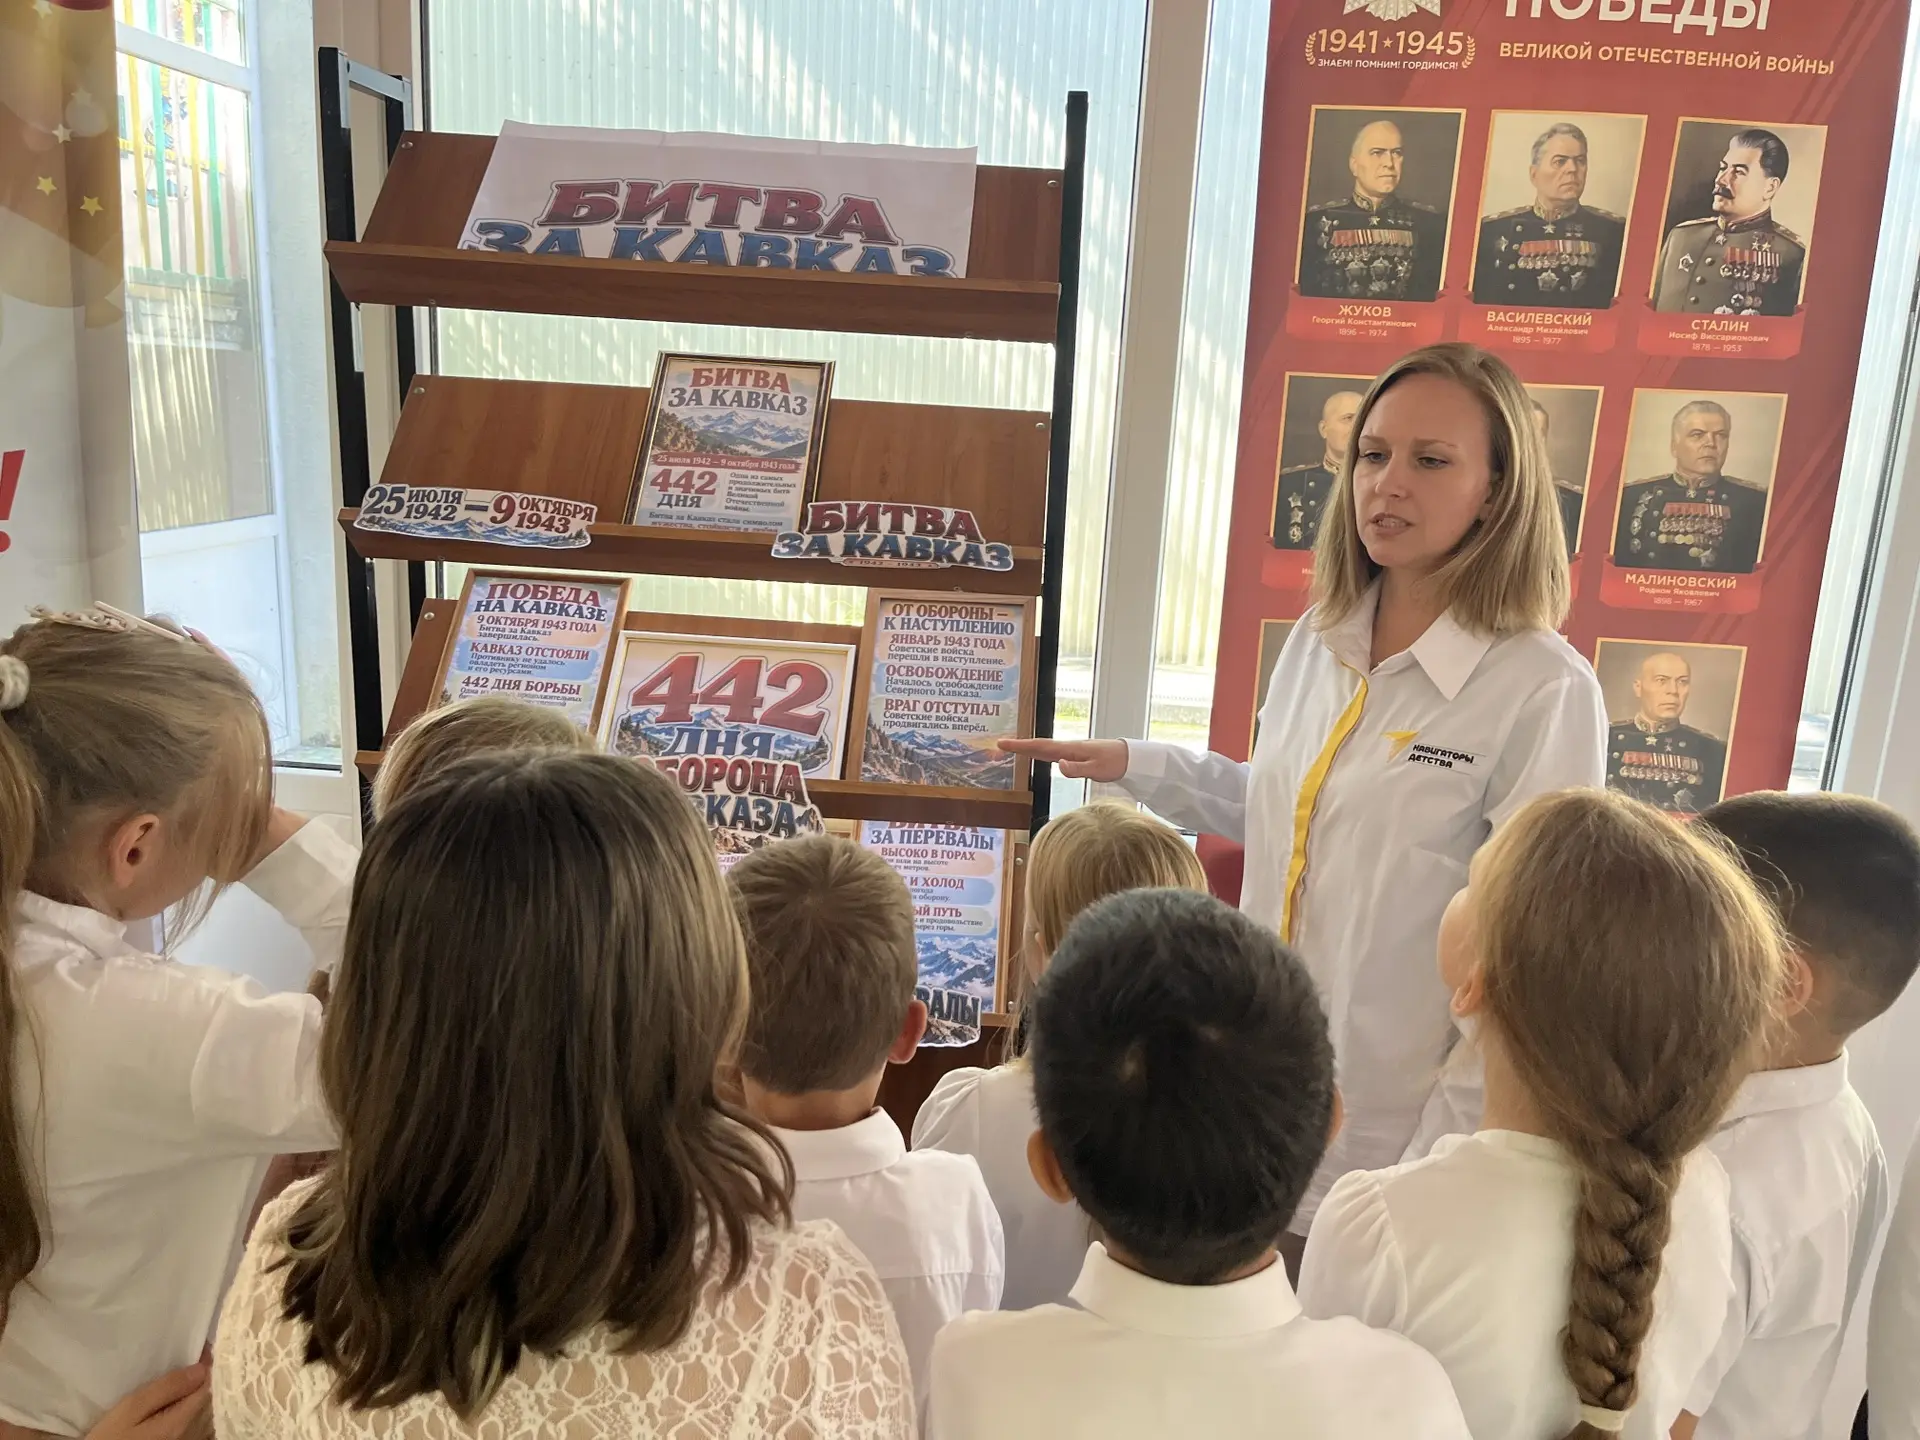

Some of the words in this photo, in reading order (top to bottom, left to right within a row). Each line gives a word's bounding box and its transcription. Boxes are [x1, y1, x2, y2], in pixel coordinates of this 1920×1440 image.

[1317, 29, 1379, 54] 1941
[1395, 30, 1464, 55] 1945
[1317, 58, 1353, 68] ЗНАЕМ!
[1355, 59, 1400, 69] ПОМНИМ!
[1402, 61, 1459, 71] ГОРДИМСЯ!
[1499, 41, 1593, 61] ВЕЛИКОЙ
[1598, 45, 1761, 71] ОТЕЧЕСТВЕННОЙ
[1765, 54, 1835, 75] ВОЙНЫ
[537, 180, 898, 245] БИТВА
[477, 221, 585, 257] ЗА
[609, 227, 957, 278] КАВКАЗ
[1338, 305, 1392, 317] ЖУКОВ
[1486, 311, 1593, 326] ВАСИЛЕВСКИЙ
[1312, 316, 1346, 325] Георгий
[1347, 317, 1417, 328] Константинович
[1487, 324, 1534, 333] Александр
[1536, 326, 1588, 335] Михайлович
[1691, 320, 1750, 332] СТАЛИН
[1368, 329, 1388, 337] 1974
[1668, 331, 1698, 341] Иосиф
[1700, 332, 1769, 342] Виссарионович
[690, 367, 791, 394] БИТВА
[668, 387, 703, 408] ЗА
[710, 389, 808, 415] КАВКАЗ
[657, 454, 667, 463] 25
[693, 456, 711, 465] 1942
[721, 459, 727, 467] 9
[727, 459, 759, 469] октября
[761, 460, 778, 469] 1943
[779, 463, 796, 471] года
[650, 469, 718, 496] 442
[363, 486, 407, 515] 25
[407, 489, 463, 504] ИЮЛЯ
[657, 494, 702, 509] ДНЯ
[403, 503, 457, 521] 1942
[489, 494, 517, 524] 9
[518, 496, 595, 523] ОКТЯБРЯ
[514, 512, 572, 534] 1943
[805, 502, 985, 544] БИТВА
[773, 532, 833, 558] ЗА
[842, 534, 1012, 570] КАВКАЗ
[1625, 573, 1737, 589] МАЛИНОВСКИЙ
[485, 583, 602, 607] ПОБЕДА
[1639, 586, 1671, 595] Родион
[474, 600, 505, 613] НА
[510, 600, 608, 622] КАВКАЗЕ
[892, 603, 914, 616] ОТ
[917, 604, 994, 621] ОБОРОНЫ
[477, 615, 484, 624] 9
[486, 616, 539, 628] ОКТЯБРЯ
[542, 619, 567, 631] 1943
[569, 621, 597, 632] ГОДА
[479, 624, 506, 632] Битва
[520, 627, 552, 636] Кавказ
[883, 617, 896, 631] К
[900, 618, 1015, 636] НАСТУПЛЕНИЮ
[477, 631, 541, 641] завершилась.
[890, 634, 941, 646] ЯНВАРЬ
[944, 635, 970, 647] 1943
[974, 637, 1005, 650] ГОДА
[470, 642, 523, 656] КАВКАЗ
[525, 646, 590, 660] ОТСТОЯЛИ
[470, 653, 520, 662] Противнику
[888, 644, 939, 655] Советские
[941, 646, 974, 656] войска
[469, 660, 507, 668] овладеть
[508, 662, 547, 671] регионом
[887, 653, 931, 662] перешли
[941, 655, 1006, 666] наступление.
[885, 664, 1004, 682] ОСВОБОЖДЕНИЕ
[462, 675, 489, 688] 442
[491, 678, 522, 691] ДНЯ
[524, 680, 582, 695] БОРЬБЫ
[885, 684, 936, 696] Северного
[938, 688, 982, 698] Кавказа.
[886, 677, 932, 687] Началось
[935, 679, 1004, 691] освобождение
[631, 655, 829, 736] 442
[884, 698, 920, 711] ВРАГ
[923, 700, 1000, 716] ОТСТУПАЛ
[883, 710, 933, 721] Советские
[935, 713, 969, 722] войска
[883, 720, 949, 730] продвигались
[952, 722, 989, 733] вперёд.
[661, 728, 775, 758] ДНЯ
[1408, 753, 1453, 768] ДЕТСТВА
[1413, 744, 1474, 764] НАВИГАТОРЫ
[640, 757, 809, 806] БОРОНА
[696, 794, 797, 838] КАЗА
[870, 829, 894, 844] ЗА
[898, 830, 994, 851] ПЕРЕВАЛЫ
[881, 847, 928, 859] ВЫСОКО
[930, 850, 938, 859] В
[940, 850, 976, 861] ГОРАХ
[910, 877, 918, 886] И
[922, 878, 965, 890] ХОЛОД
[918, 894, 951, 902] оборону.
[933, 907, 962, 918] ПУТЬ
[926, 918, 983, 927] продовольствие
